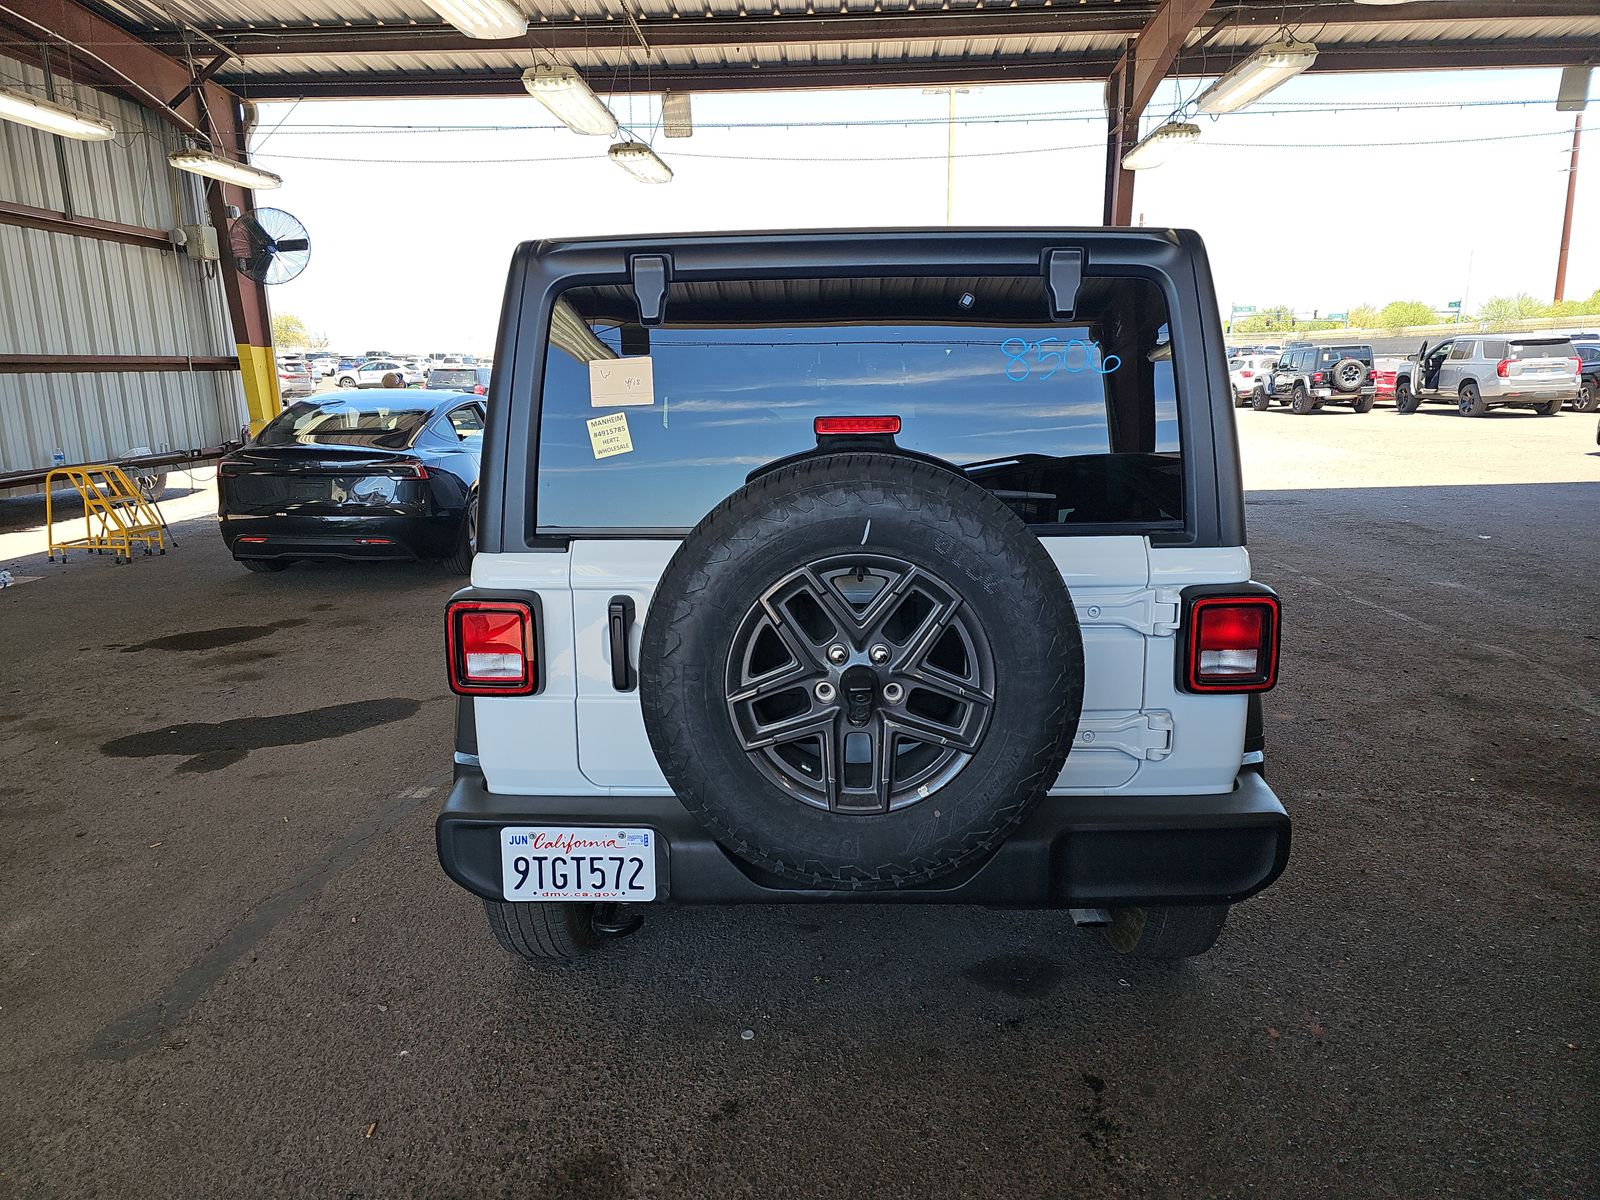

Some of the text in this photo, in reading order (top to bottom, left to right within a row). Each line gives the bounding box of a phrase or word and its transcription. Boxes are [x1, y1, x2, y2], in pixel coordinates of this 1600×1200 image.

[1001, 337, 1121, 382] 8506
[590, 414, 624, 428] MANHEIM
[593, 425, 626, 438] #4915785
[602, 436, 620, 446] HERTZ
[597, 442, 630, 455] WHOLESALE
[509, 835, 529, 845] JUN
[533, 832, 626, 854] California
[513, 856, 645, 890] 9TGT572
